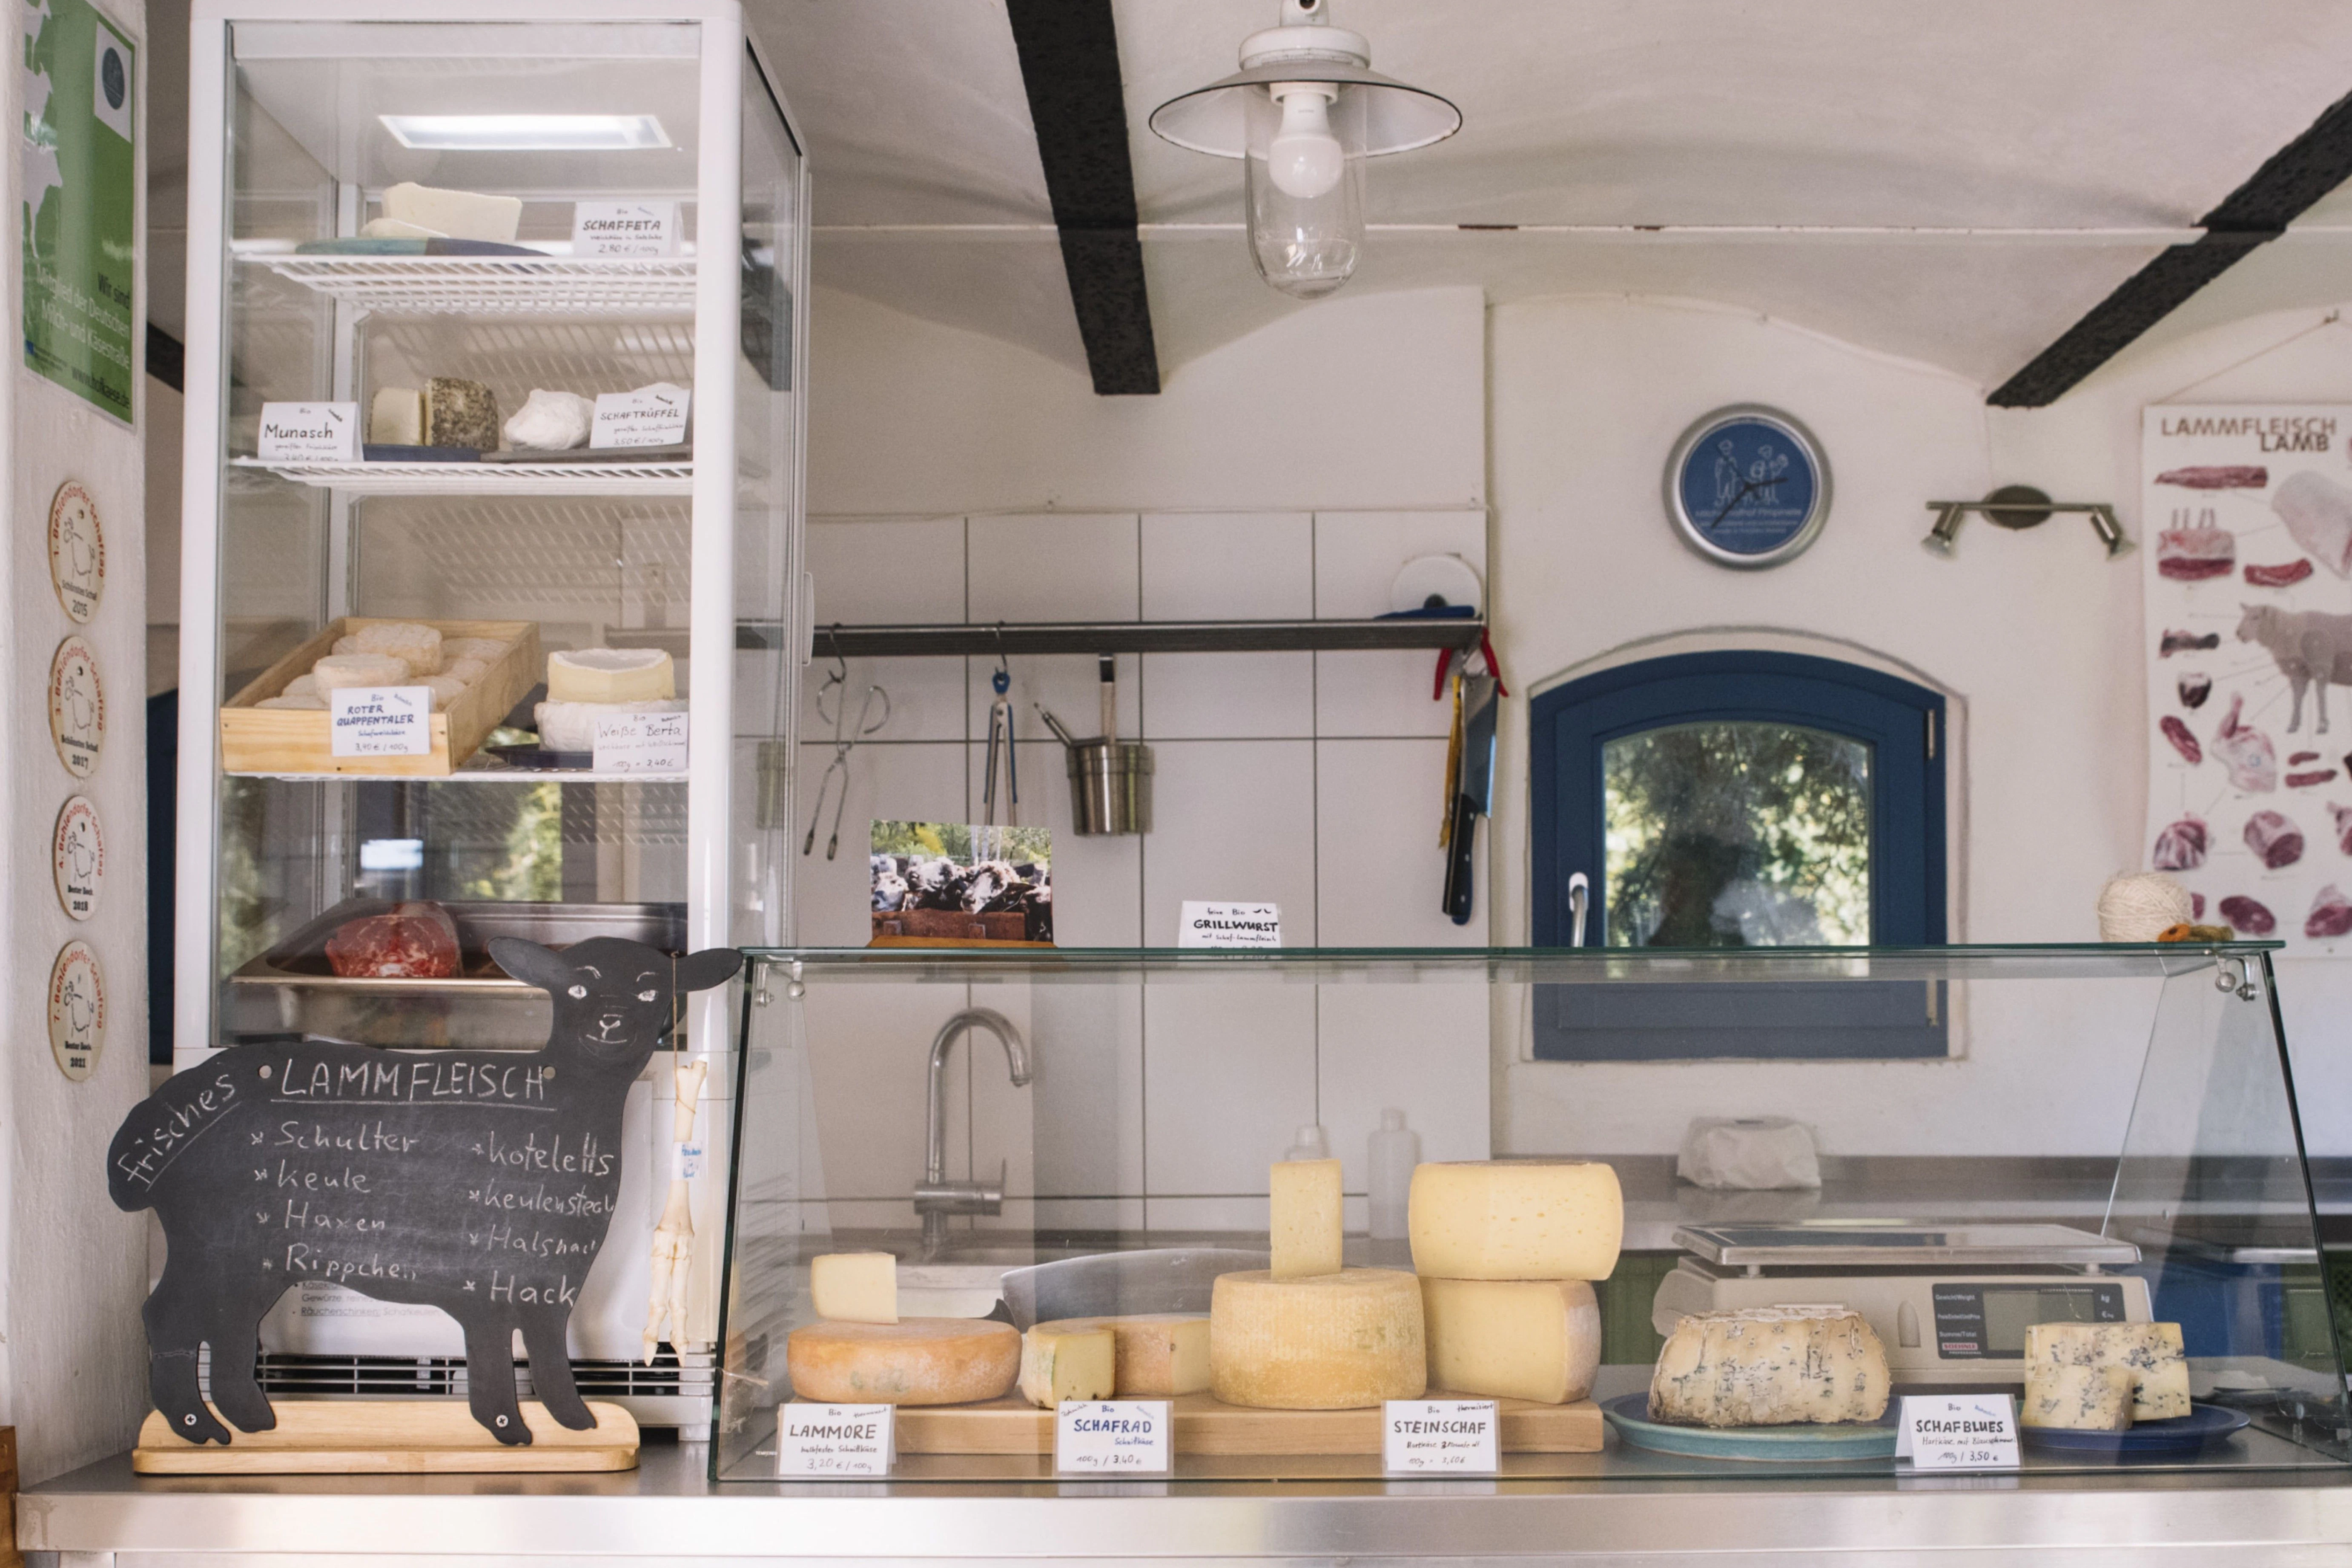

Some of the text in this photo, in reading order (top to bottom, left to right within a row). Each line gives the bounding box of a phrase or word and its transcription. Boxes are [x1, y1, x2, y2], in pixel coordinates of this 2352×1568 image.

[583, 220, 661, 231] SCHAFFETA
[98, 272, 130, 310] Wir sind
[37, 264, 129, 340] Mitglied der Deutschen
[42, 298, 68, 331] Milch-
[69, 321, 86, 344] und
[87, 327, 130, 370] Käsestraße
[600, 407, 680, 421] SCHAFTRÜFFEL
[264, 422, 333, 439] Munasch
[2161, 417, 2337, 436] LAMMFLEISCH
[2259, 433, 2330, 452] LAMB
[371, 694, 384, 702] Bio
[347, 704, 384, 714] ROTER
[336, 714, 414, 727] QUAPPENTALER
[597, 722, 681, 739] Weiße Berta
[72, 754, 89, 770] 2017
[73, 900, 88, 911] 2018
[1194, 919, 1278, 932] GRILLWURST
[70, 1057, 86, 1068] 2021
[281, 1058, 544, 1101] LAMMFLEISCH
[274, 1120, 421, 1153] Schulter
[285, 1199, 385, 1232] Haxen
[286, 1242, 417, 1282] Rippchen
[490, 1270, 578, 1307] Hack
[1948, 1403, 1961, 1411] Bio
[789, 1424, 877, 1439] LAMMORE
[1074, 1419, 1152, 1433] SCHAFRAD
[1394, 1420, 1486, 1434] STEINSCHAF
[1916, 1419, 2004, 1433] SCHAFBLUES
[1076, 1455, 1099, 1466] 100g
[1970, 1450, 1990, 1462] 3,50
[806, 1458, 834, 1471] 3,20
[852, 1463, 872, 1473] 100g
